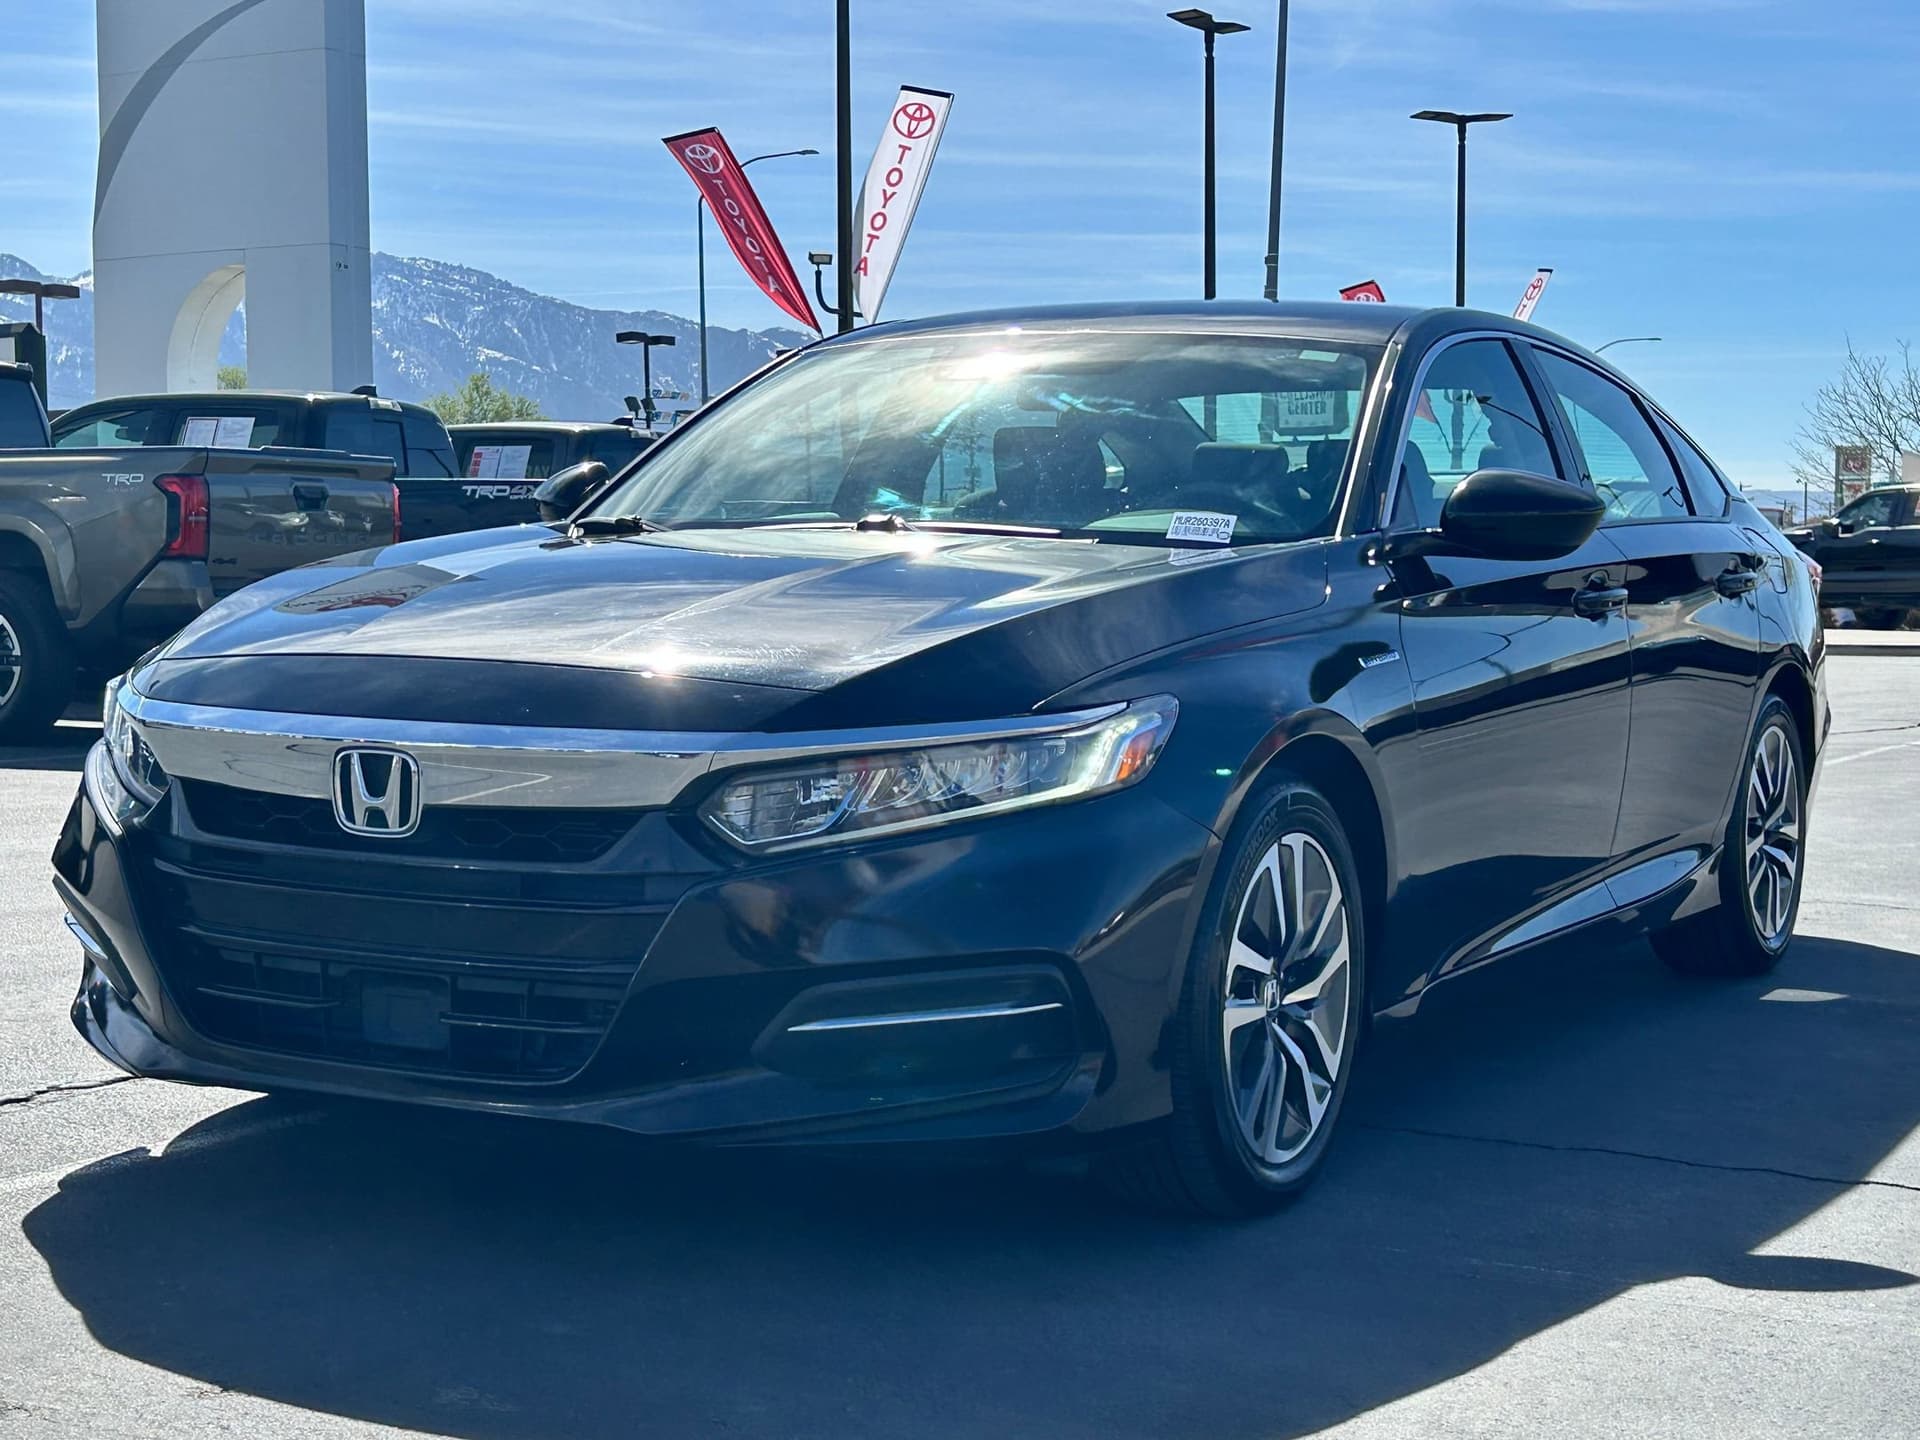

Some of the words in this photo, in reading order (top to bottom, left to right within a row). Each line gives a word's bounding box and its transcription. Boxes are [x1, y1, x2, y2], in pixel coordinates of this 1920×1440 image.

[853, 143, 912, 277] TOYOTA
[711, 179, 783, 293] TOYOTA
[1288, 401, 1327, 415] CENTER
[101, 473, 144, 486] TRD
[462, 485, 511, 500] TRD
